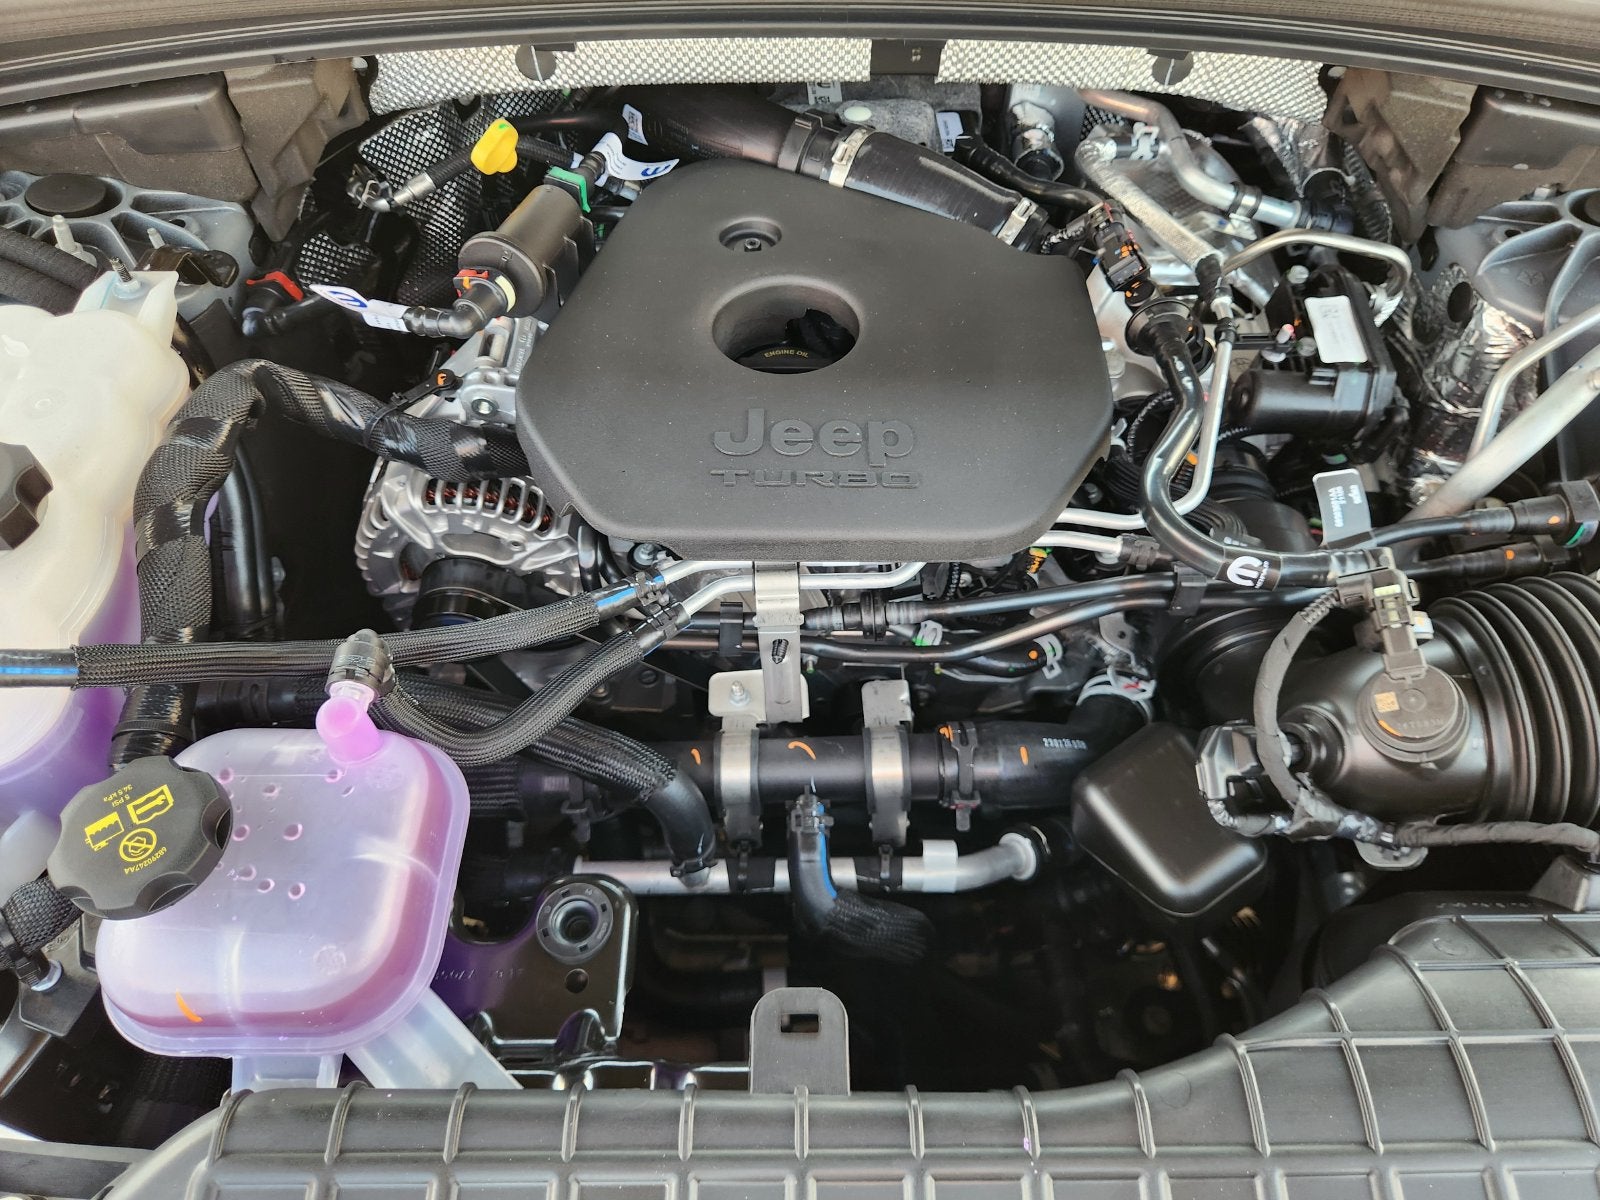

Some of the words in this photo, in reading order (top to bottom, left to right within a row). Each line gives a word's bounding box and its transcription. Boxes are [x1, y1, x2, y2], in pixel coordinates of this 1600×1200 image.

[763, 349, 794, 358] ENGINE
[796, 350, 809, 358] OIL
[713, 408, 914, 468] Jeep
[710, 469, 920, 488] TURBO
[103, 791, 118, 802] kPa
[124, 793, 130, 801] 5
[111, 797, 124, 808] PSI
